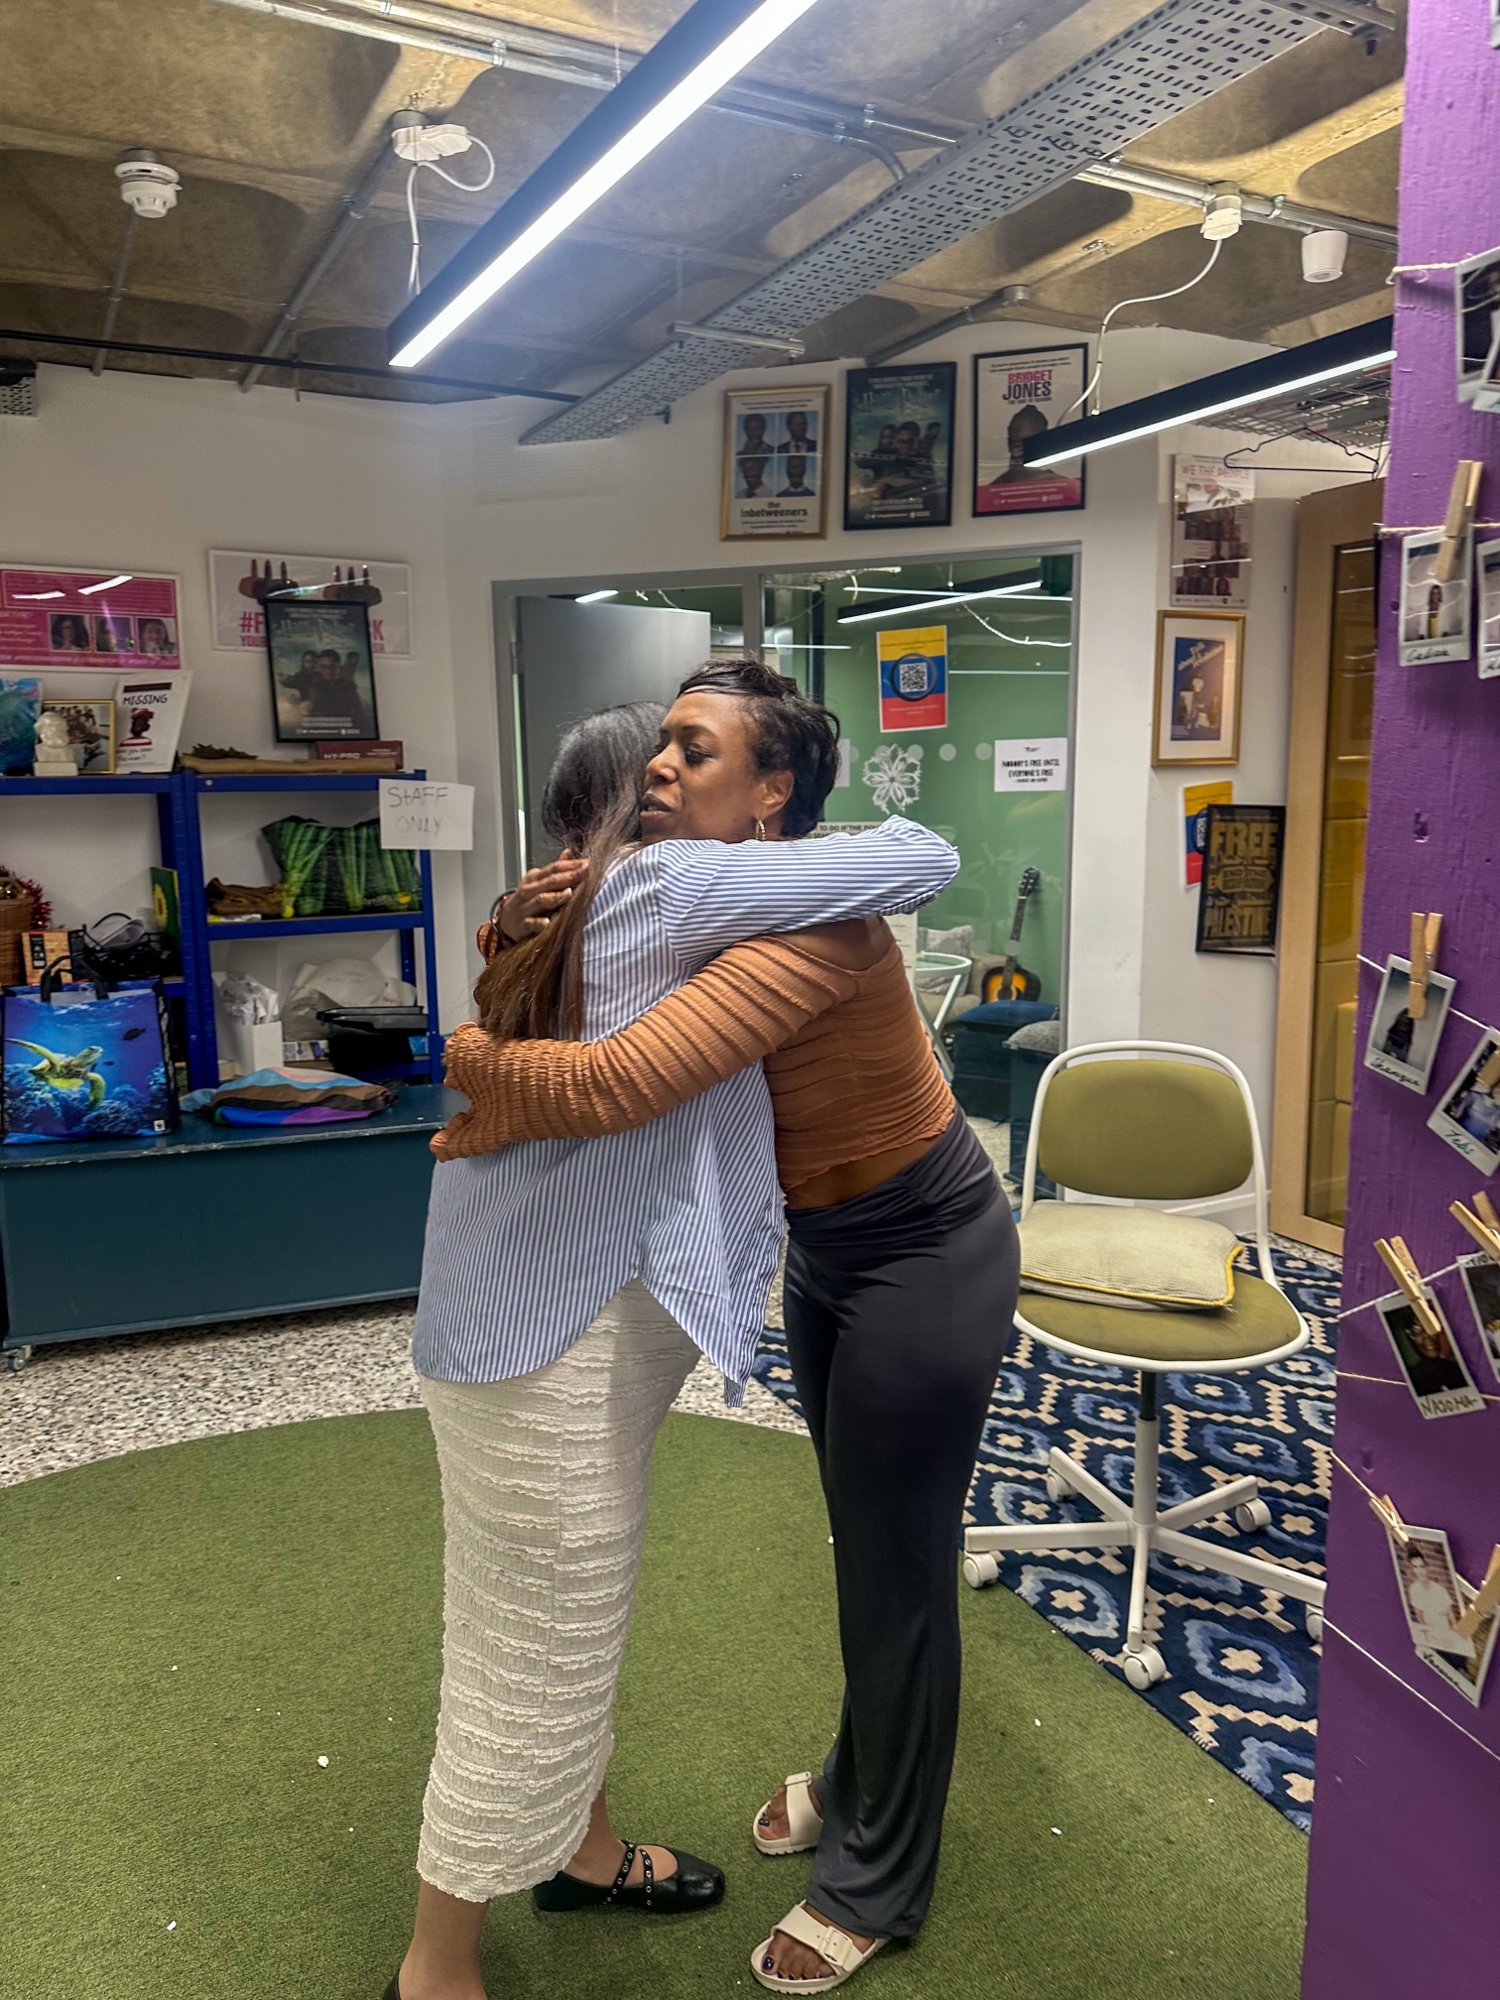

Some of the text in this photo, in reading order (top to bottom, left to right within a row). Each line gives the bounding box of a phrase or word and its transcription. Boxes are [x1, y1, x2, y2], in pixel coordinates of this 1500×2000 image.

[1008, 369, 1053, 383] BRIDGET
[1003, 381, 1051, 400] JONES
[766, 501, 781, 509] the
[123, 695, 168, 705] MISSING
[396, 815, 443, 838] ONLY
[1210, 821, 1279, 856] FREE
